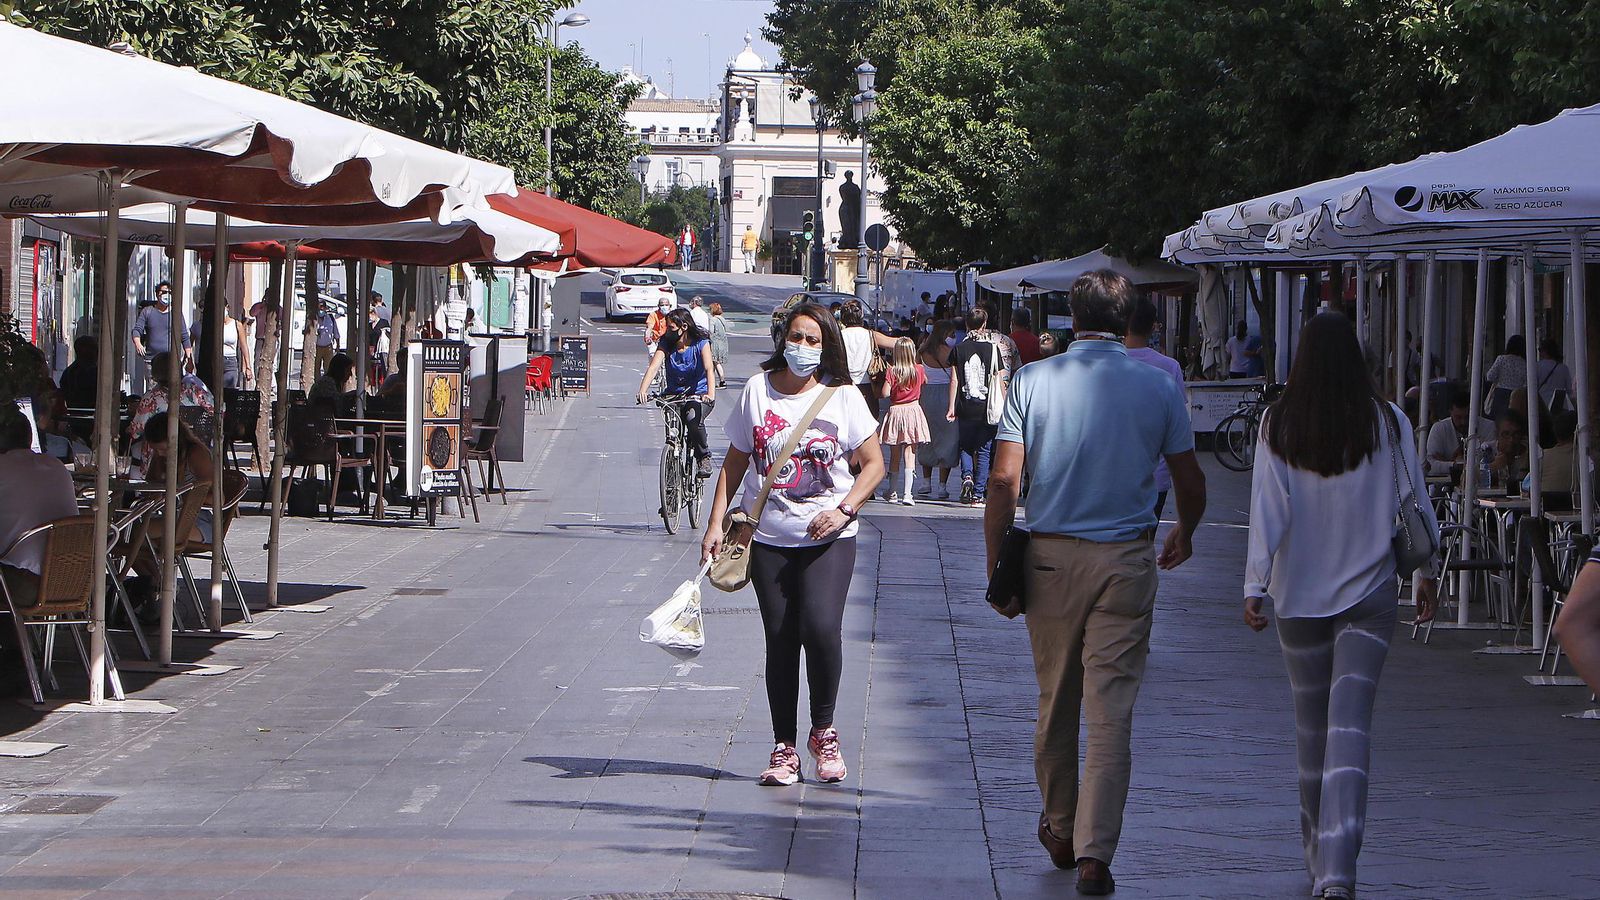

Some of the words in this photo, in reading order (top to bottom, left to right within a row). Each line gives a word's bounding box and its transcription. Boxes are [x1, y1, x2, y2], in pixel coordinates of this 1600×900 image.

[1427, 188, 1485, 213] MAX
[1494, 202, 1521, 210] ZERO
[424, 346, 461, 361] ARROCES
